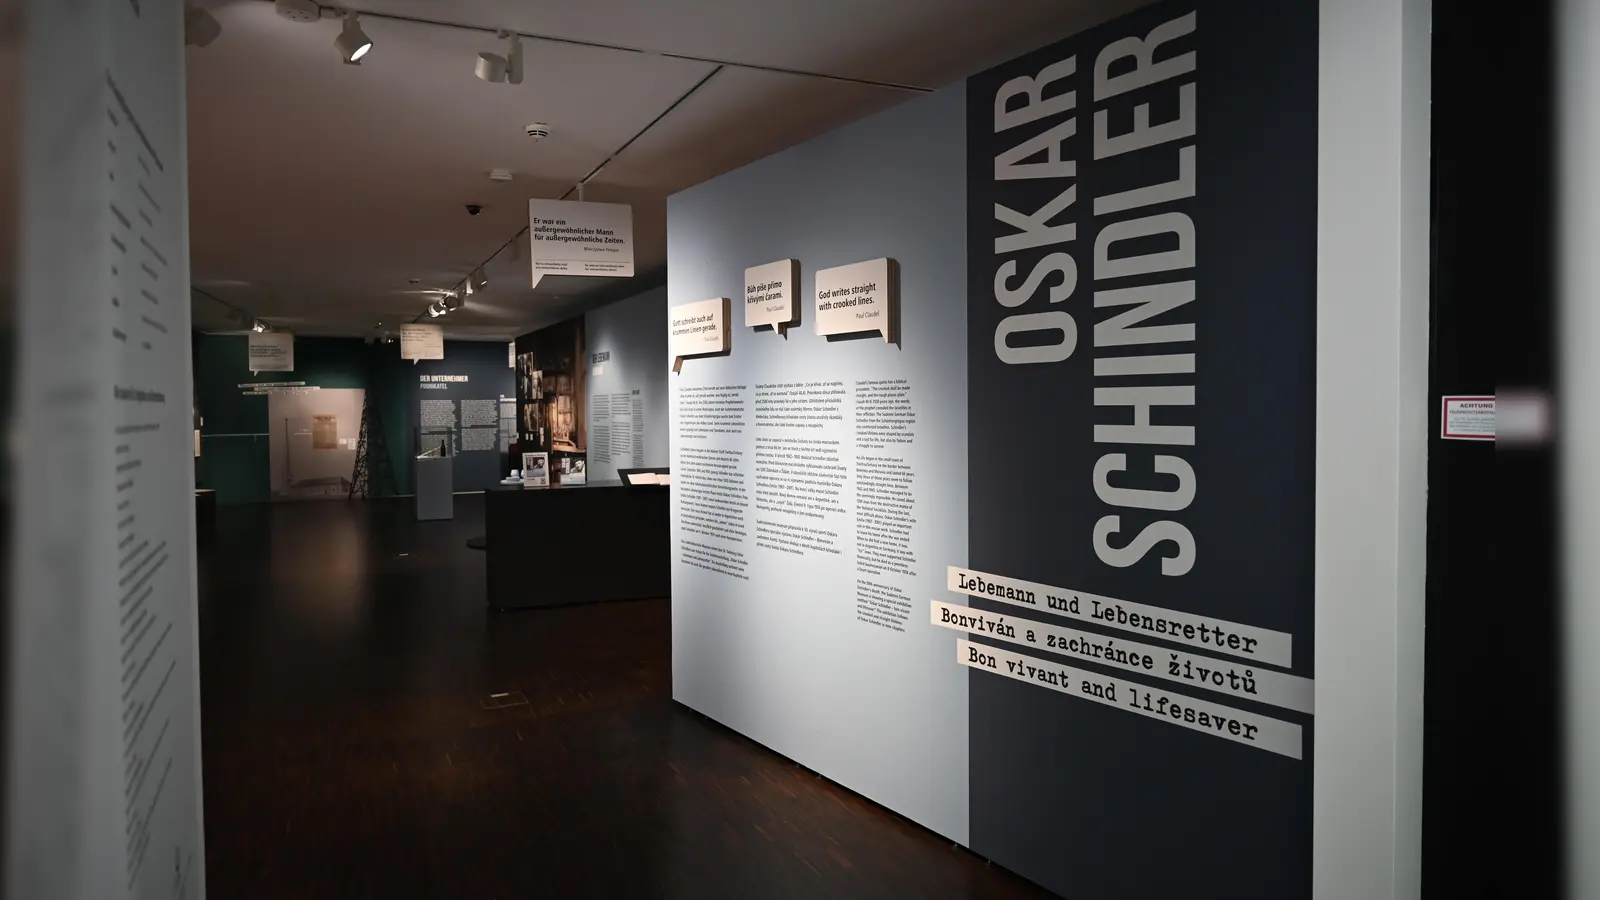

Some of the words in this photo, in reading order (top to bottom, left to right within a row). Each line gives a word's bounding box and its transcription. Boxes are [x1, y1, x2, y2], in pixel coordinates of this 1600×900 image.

[994, 54, 1077, 364] OSKAR
[534, 226, 594, 236] außergewöhnlicher
[546, 235, 603, 243] außergewöhnliche
[747, 285, 756, 293] Bůh
[757, 283, 766, 293] píše
[768, 280, 782, 291] přímo
[819, 289, 831, 300] God
[832, 288, 850, 298] writes
[851, 282, 876, 294] straight
[1093, 9, 1196, 576] SCHINDLER
[819, 300, 832, 310] with
[833, 297, 857, 308] crooked
[858, 296, 874, 306] lines.
[697, 314, 706, 323] auch
[864, 310, 880, 318] Claudel
[959, 574, 1036, 605] Lebemann
[1047, 594, 1081, 615] und
[1092, 600, 1258, 654] Lebensretter
[941, 607, 1016, 638] Bonviván
[1026, 630, 1036, 643] a
[1047, 636, 1154, 670] zachránce
[1168, 654, 1258, 695] životů
[968, 646, 996, 669] Bon
[1006, 660, 1069, 689] vivant
[1082, 680, 1118, 702] and
[1129, 688, 1258, 741] lifesaver
